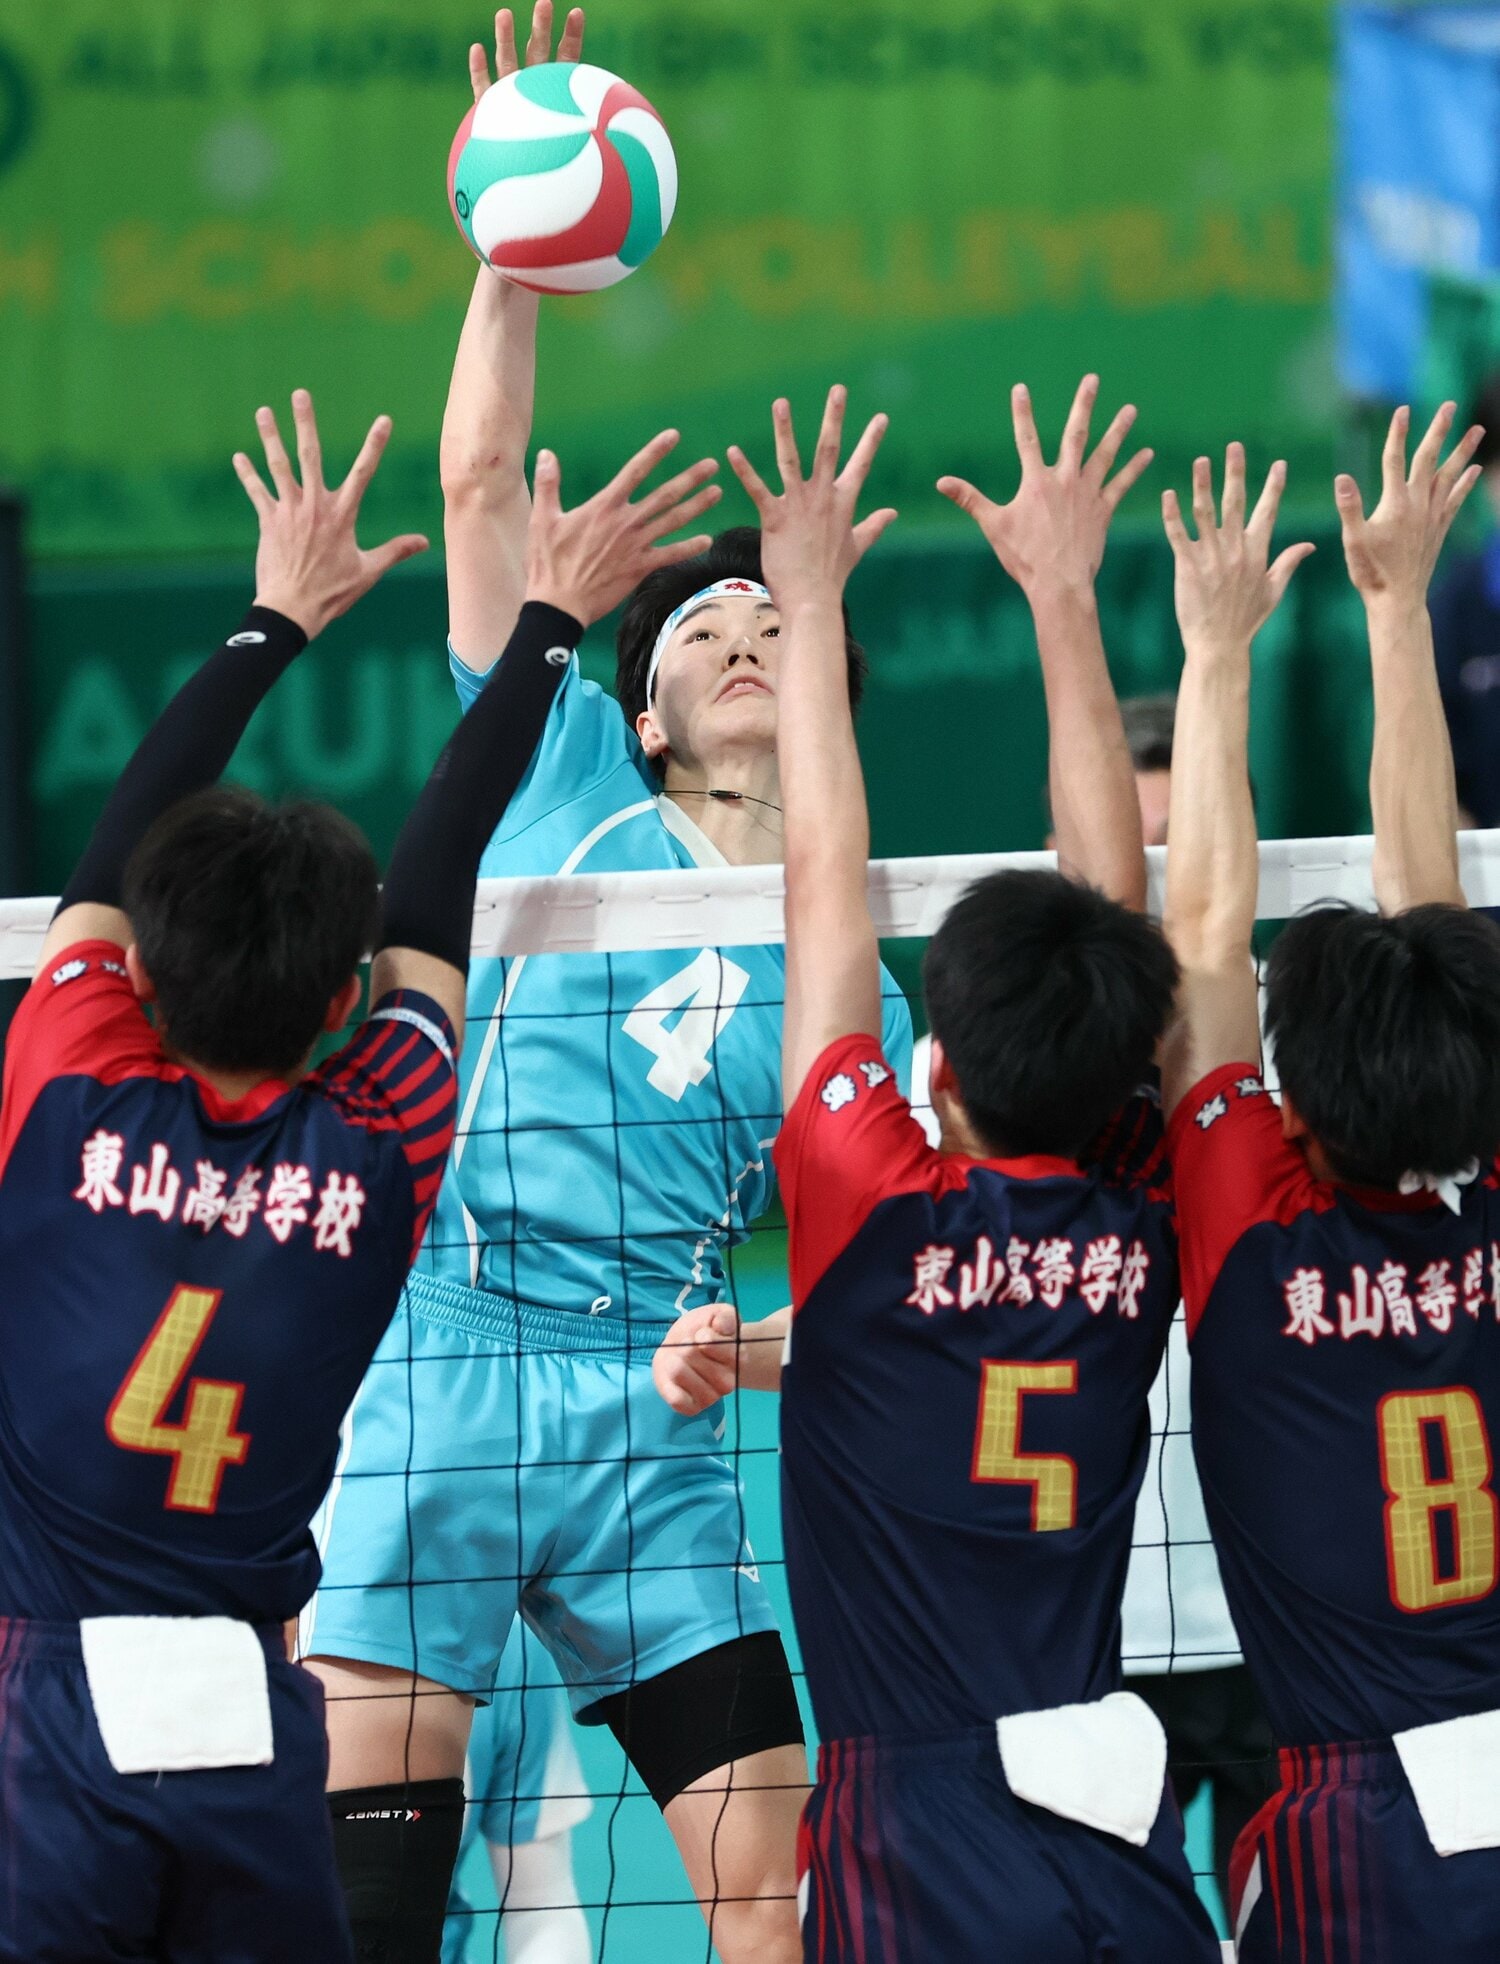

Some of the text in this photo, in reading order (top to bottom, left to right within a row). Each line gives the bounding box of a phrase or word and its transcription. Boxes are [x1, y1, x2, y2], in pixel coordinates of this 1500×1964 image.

[621, 946, 751, 1104] 4
[73, 1129, 367, 1259] 東山高等学校
[105, 1282, 251, 1515] 4
[970, 1357, 1077, 1532] 5
[1376, 1385, 1500, 1614] 8
